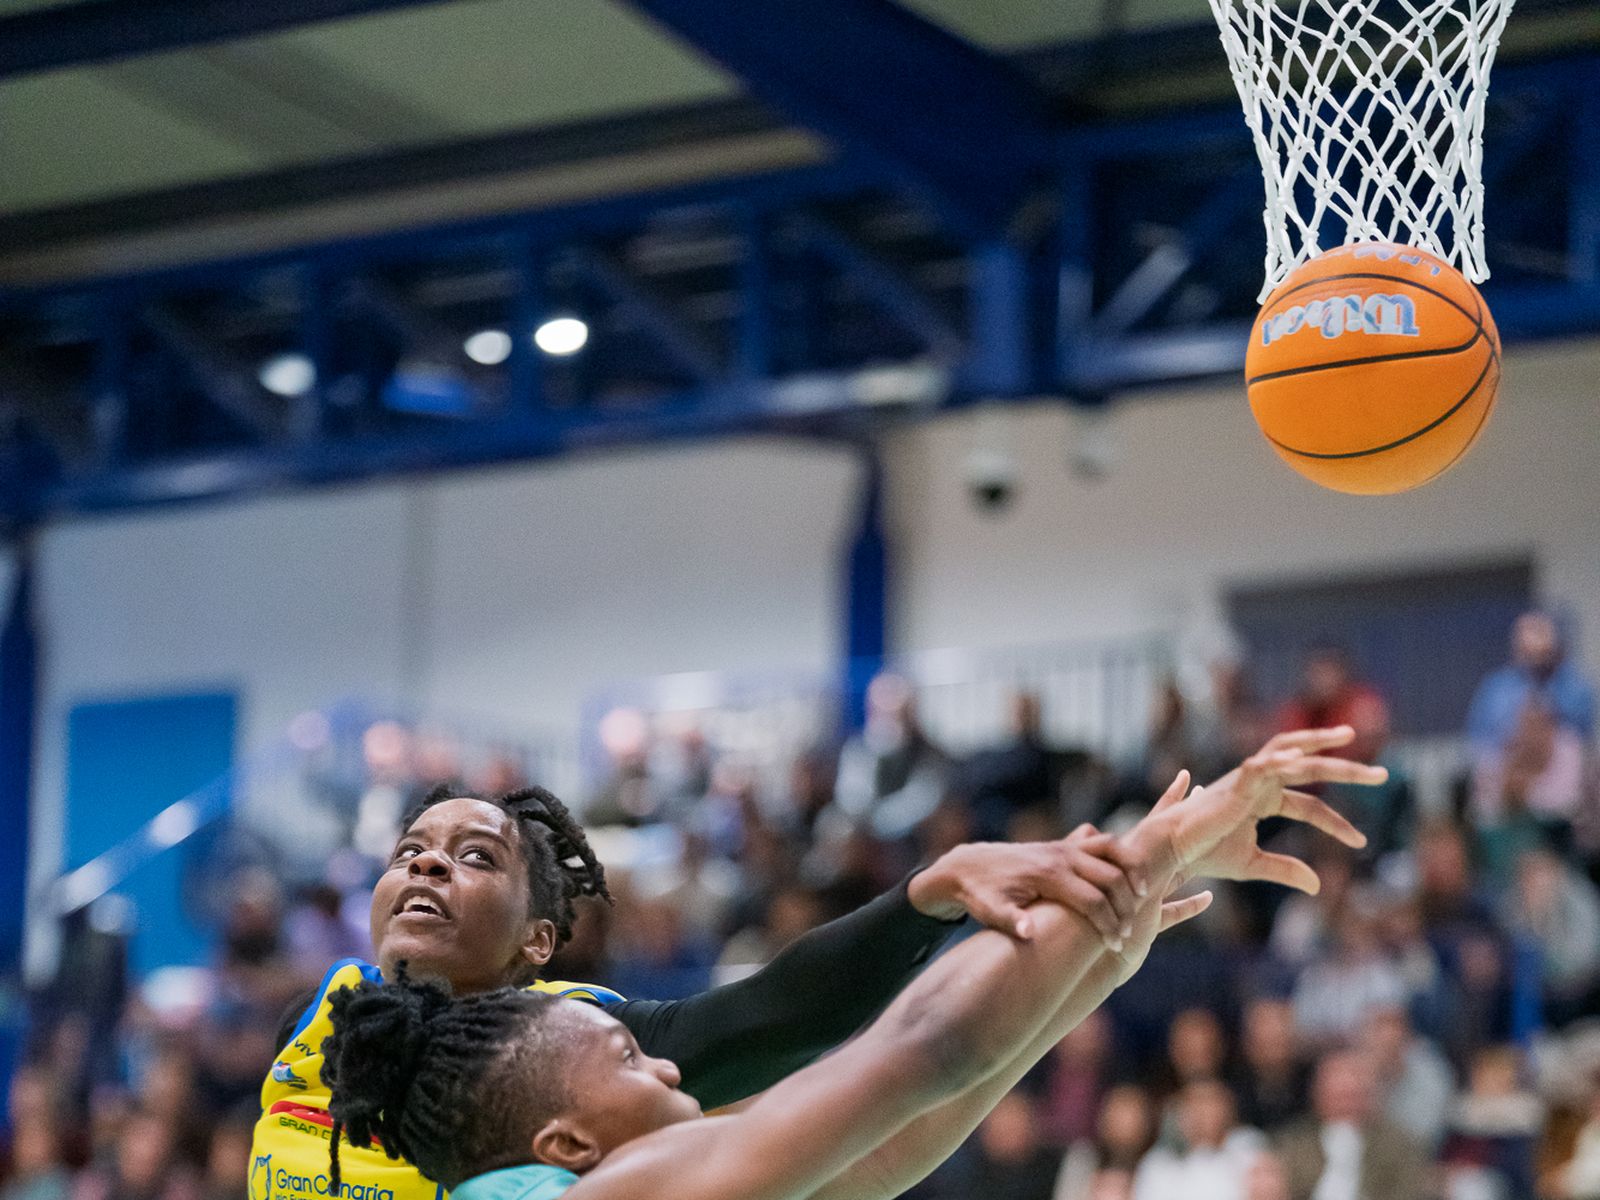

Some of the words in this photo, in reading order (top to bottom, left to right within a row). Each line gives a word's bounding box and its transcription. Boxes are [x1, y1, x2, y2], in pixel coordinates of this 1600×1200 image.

[1261, 293, 1420, 346] Wilson
[295, 1039, 317, 1056] viv
[280, 1117, 318, 1136] GRAN
